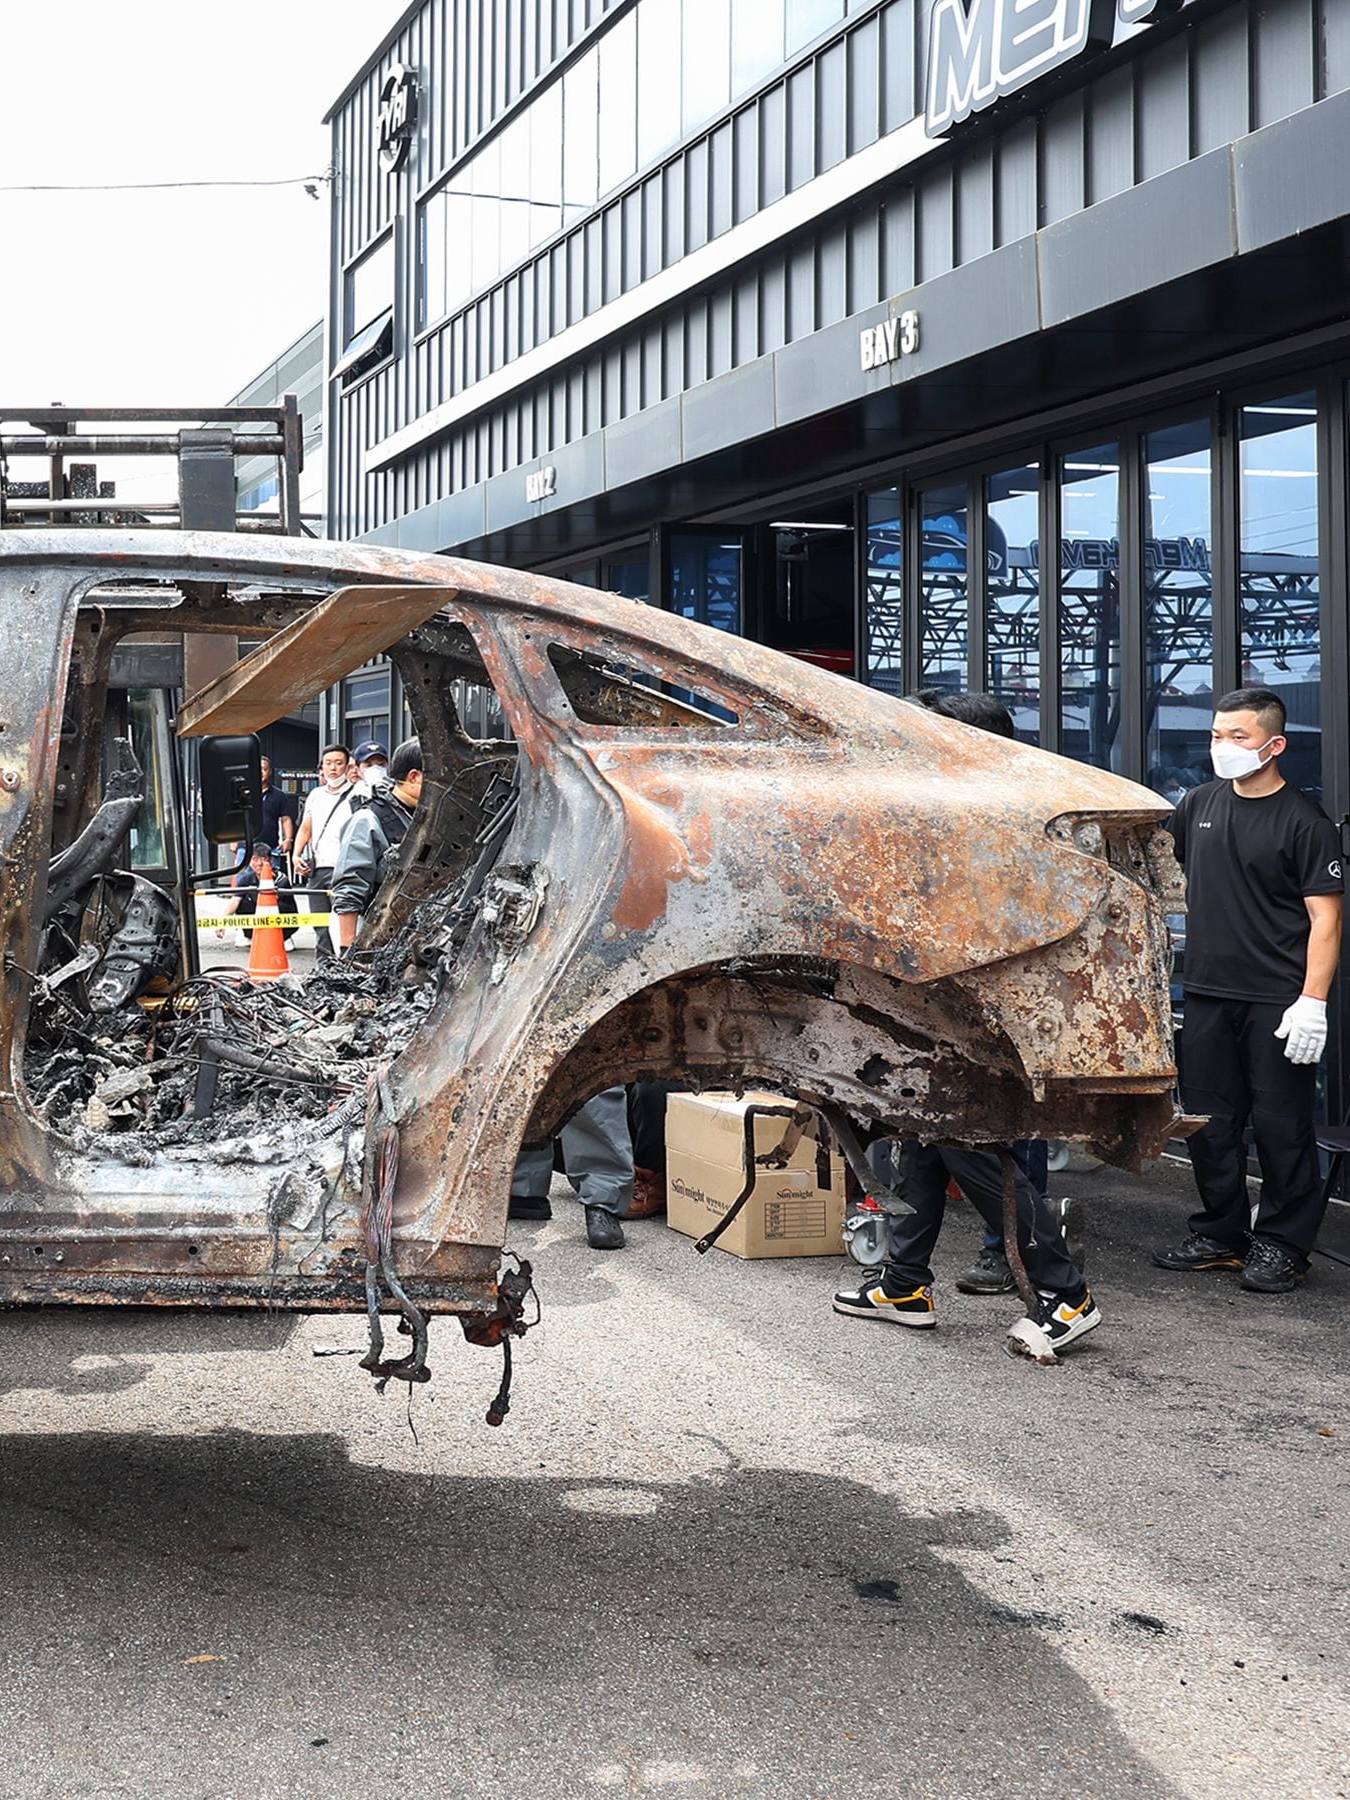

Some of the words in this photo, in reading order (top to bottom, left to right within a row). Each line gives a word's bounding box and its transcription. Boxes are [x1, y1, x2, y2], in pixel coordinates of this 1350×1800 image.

[860, 327, 899, 371] BAY
[900, 309, 919, 354] 3
[544, 466, 554, 495] 2
